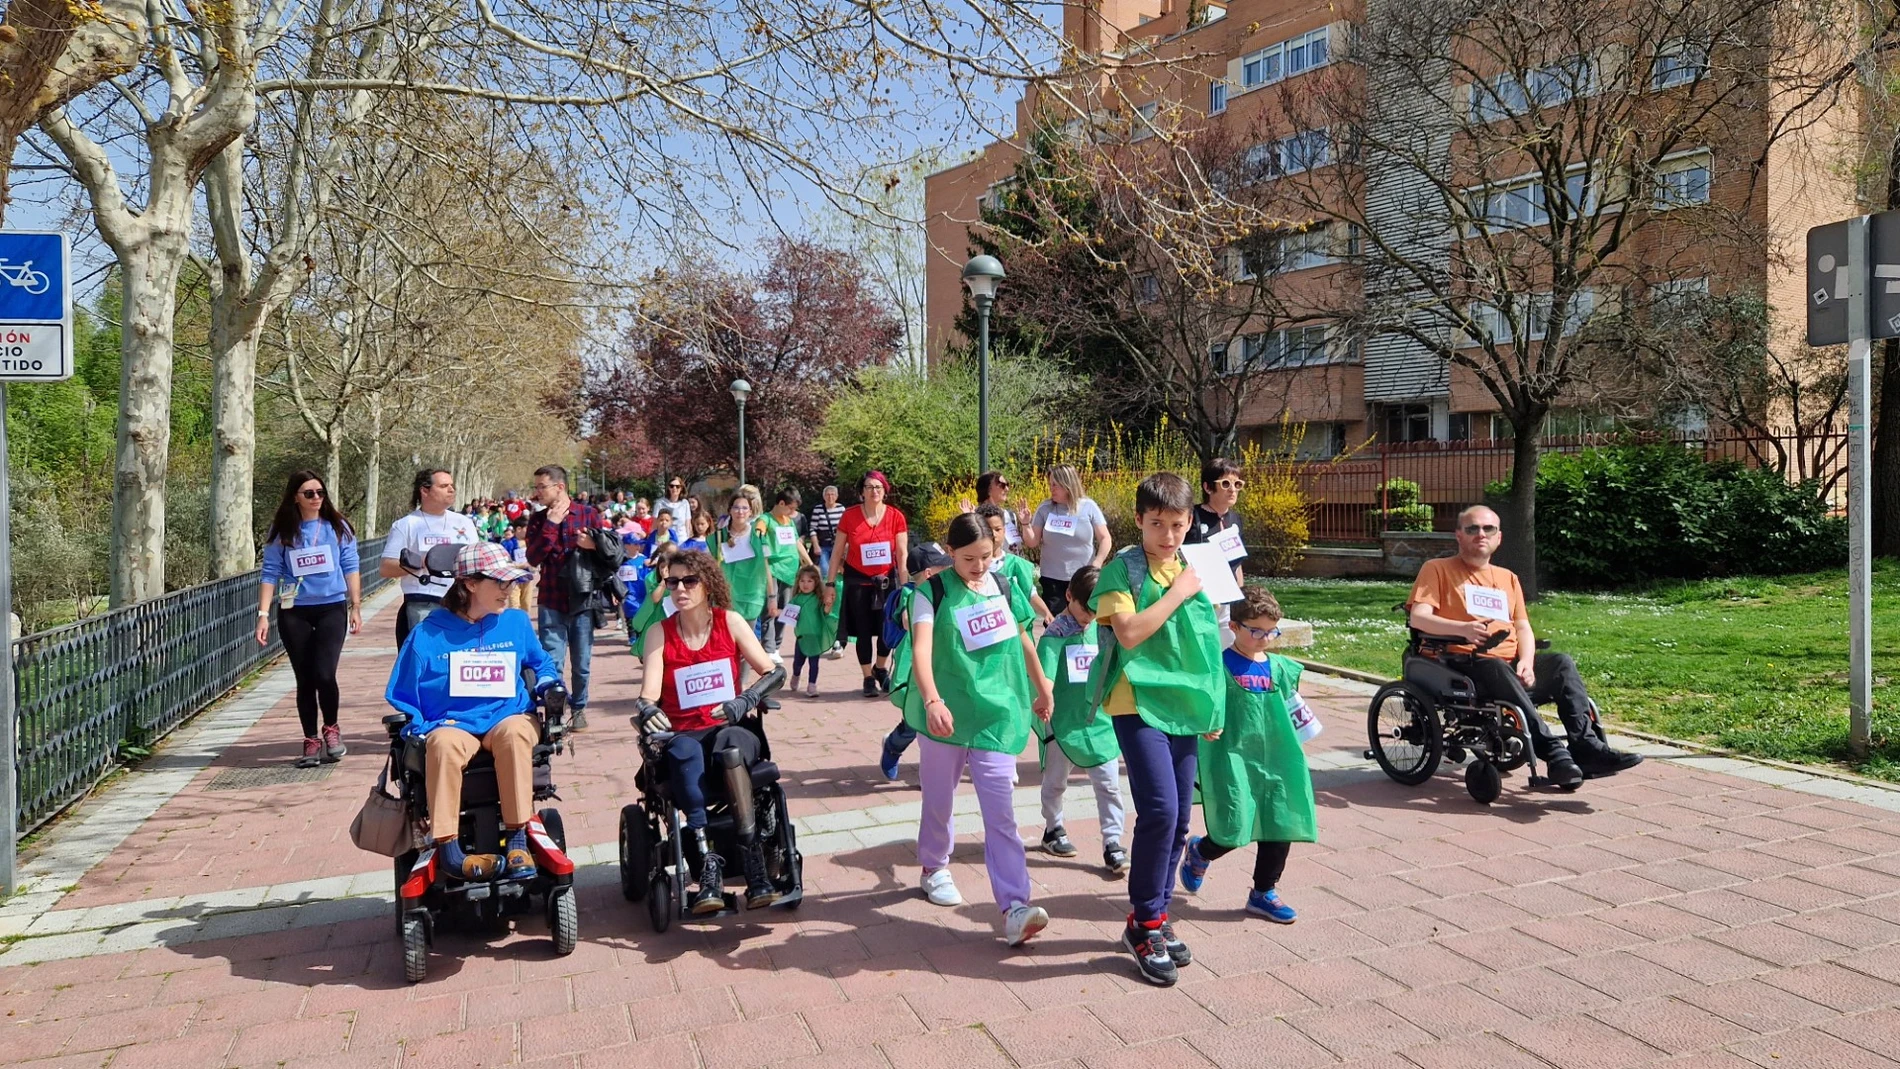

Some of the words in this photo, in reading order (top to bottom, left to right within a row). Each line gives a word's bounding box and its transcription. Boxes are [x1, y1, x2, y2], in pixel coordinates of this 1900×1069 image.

[2, 360, 43, 371] TIDO
[298, 556, 318, 566] 100
[1474, 595, 1493, 607] 006
[971, 613, 998, 633] 045
[463, 667, 491, 681] 004
[687, 676, 714, 693] 002
